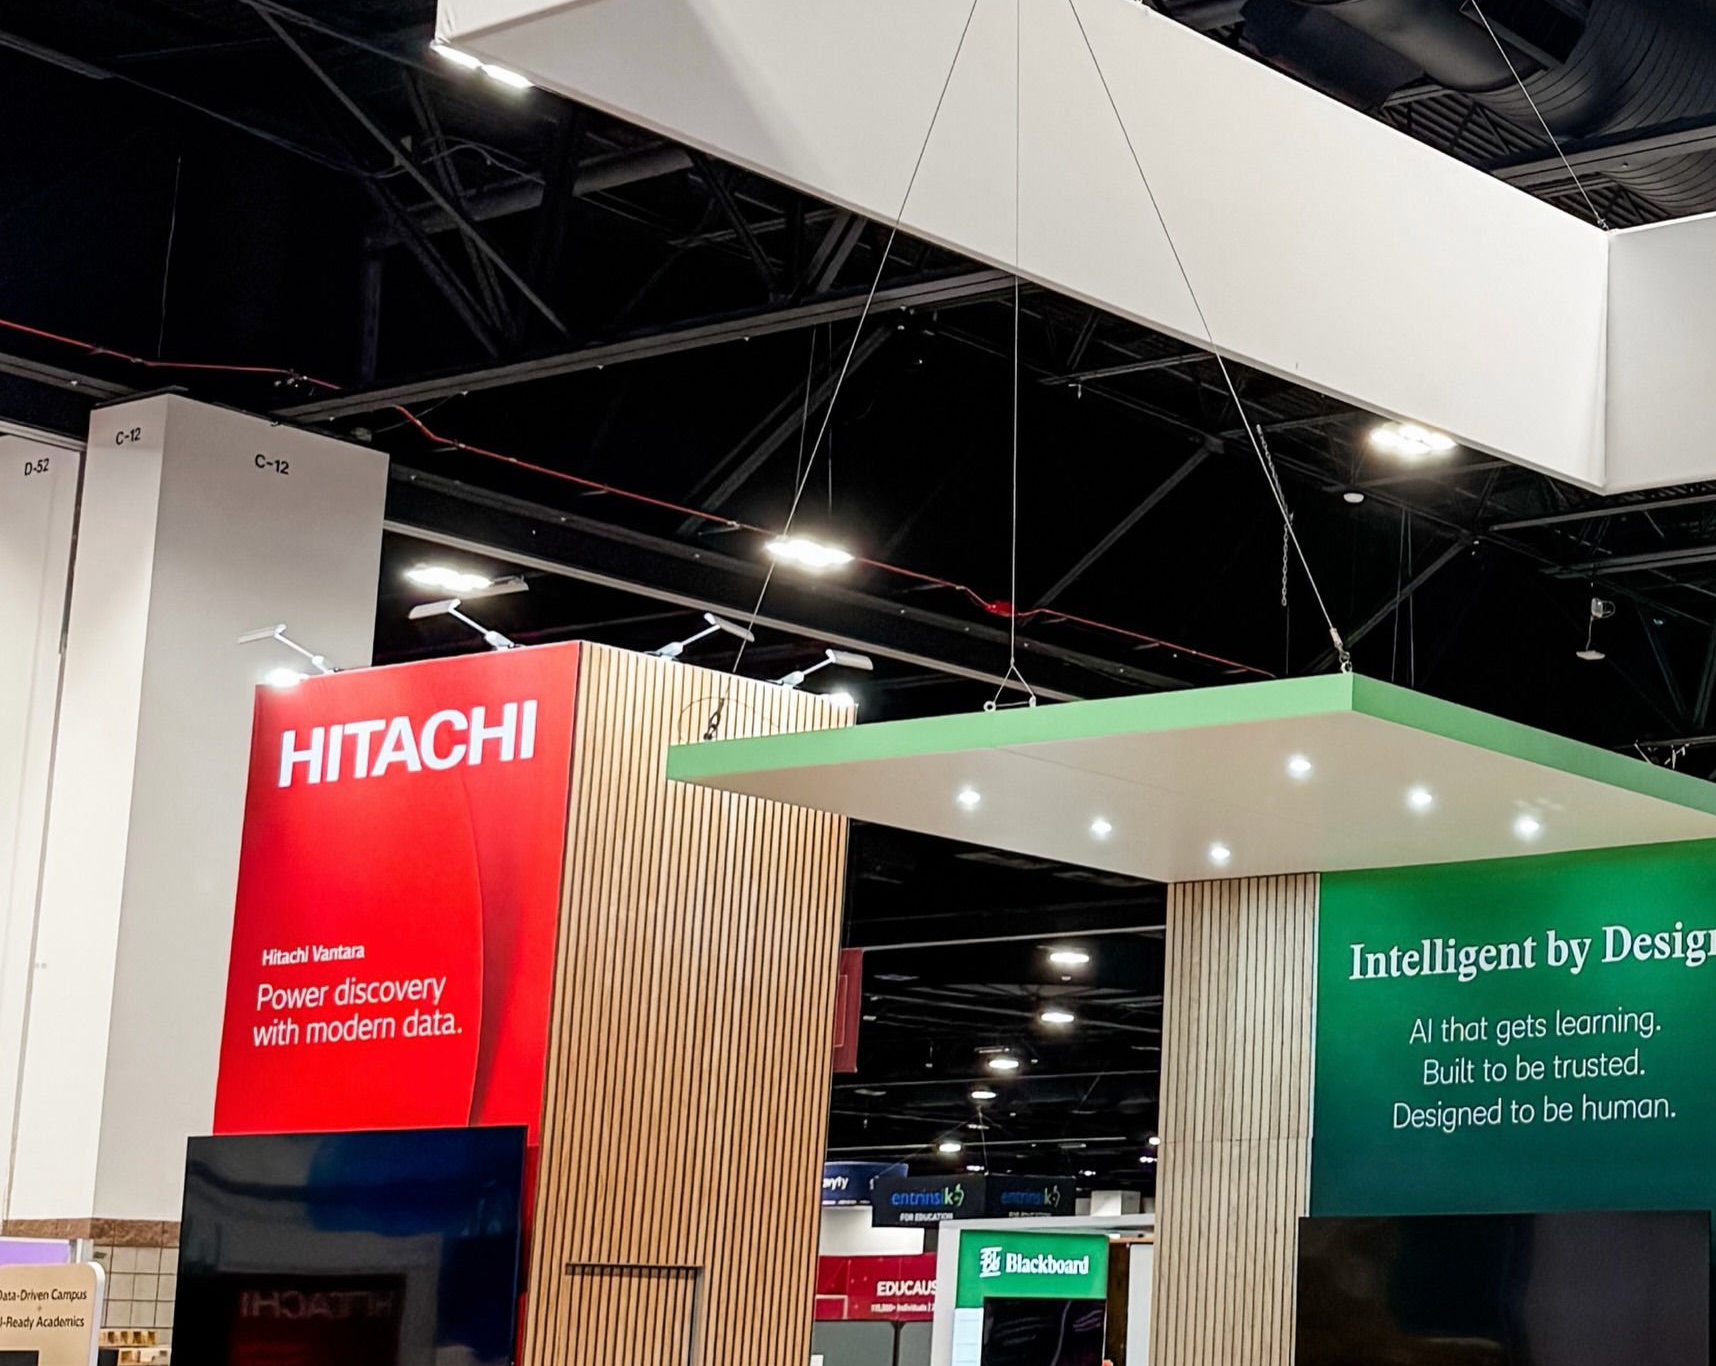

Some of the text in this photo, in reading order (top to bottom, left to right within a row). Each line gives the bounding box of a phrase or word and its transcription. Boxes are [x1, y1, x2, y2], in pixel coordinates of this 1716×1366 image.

[115, 427, 141, 445] C-12
[24, 458, 50, 476] D-52
[255, 454, 289, 475] C-12
[278, 699, 538, 788] HITACHI
[262, 944, 365, 966] Hitachi Vantara
[1349, 935, 1537, 982] Intelligent
[1546, 929, 1592, 974] by
[257, 976, 447, 1011] Power discovery
[253, 1008, 463, 1047] with modern data.
[1409, 1006, 1661, 1046] AI that gets learning.
[1423, 1047, 1646, 1085] Built to be trusted.
[1393, 1093, 1677, 1133] Designed to be human.
[1005, 1252, 1089, 1275] Blackboard
[0, 1289, 87, 1303] ata-Driven Campus
[36, 1315, 85, 1327] Academics
